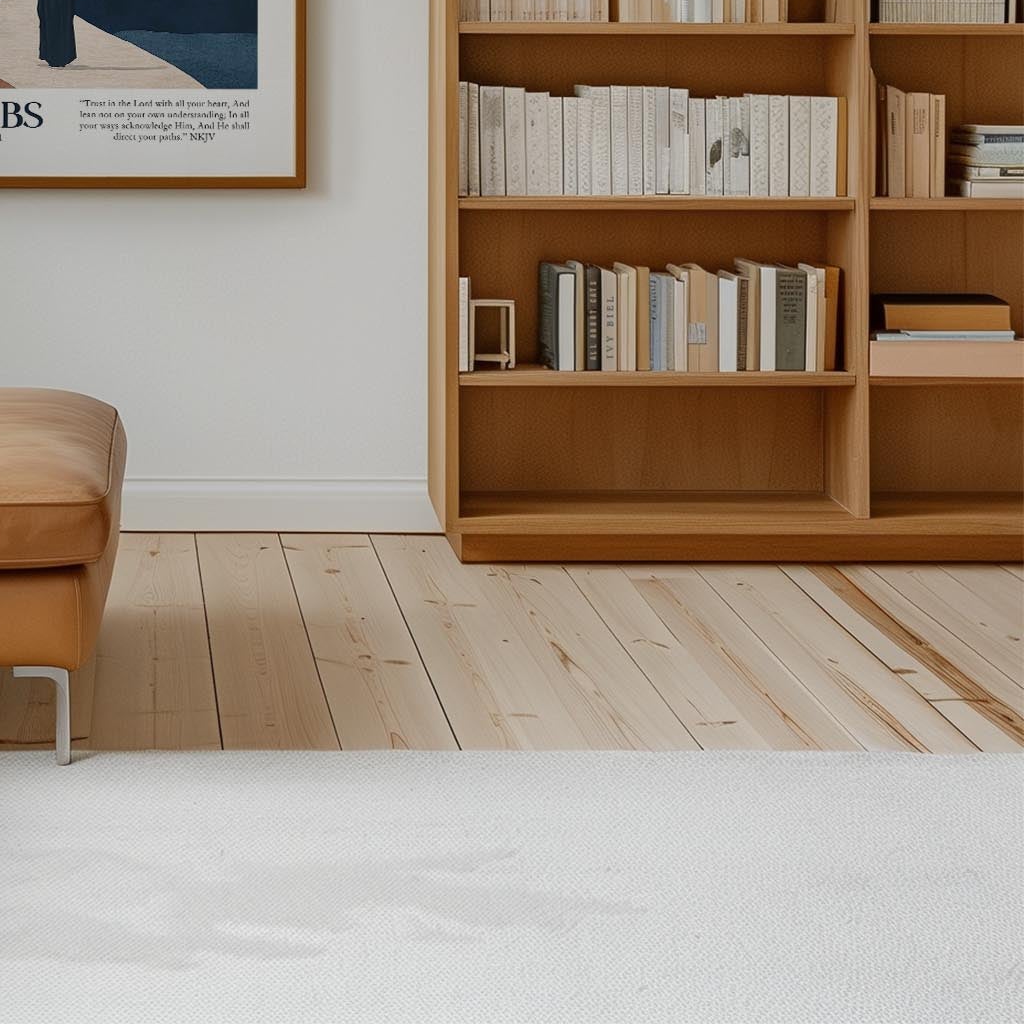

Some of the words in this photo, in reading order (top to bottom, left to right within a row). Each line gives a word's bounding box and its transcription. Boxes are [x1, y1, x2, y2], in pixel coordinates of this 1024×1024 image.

[108, 99, 116, 107] in
[118, 99, 131, 107] the
[134, 99, 153, 107] Lord
[155, 99, 173, 107] with
[175, 99, 185, 107] all
[186, 101, 206, 110] your
[207, 99, 230, 109] heart,
[234, 99, 250, 107] And
[79, 110, 97, 118] lean
[127, 112, 145, 121] your
[228, 110, 238, 118] In
[240, 110, 250, 118] all
[79, 123, 97, 132] your
[99, 123, 119, 132] ways
[121, 121, 173, 132] acknowledge
[175, 121, 195, 131] Him,
[198, 121, 215, 130] And
[217, 121, 230, 130] He
[232, 121, 250, 130] shall
[113, 132, 137, 141] direct
[138, 134, 156, 143] your
[189, 132, 216, 143] NKJV
[606, 296, 614, 327] BIEL
[606, 336, 614, 360] IVY
